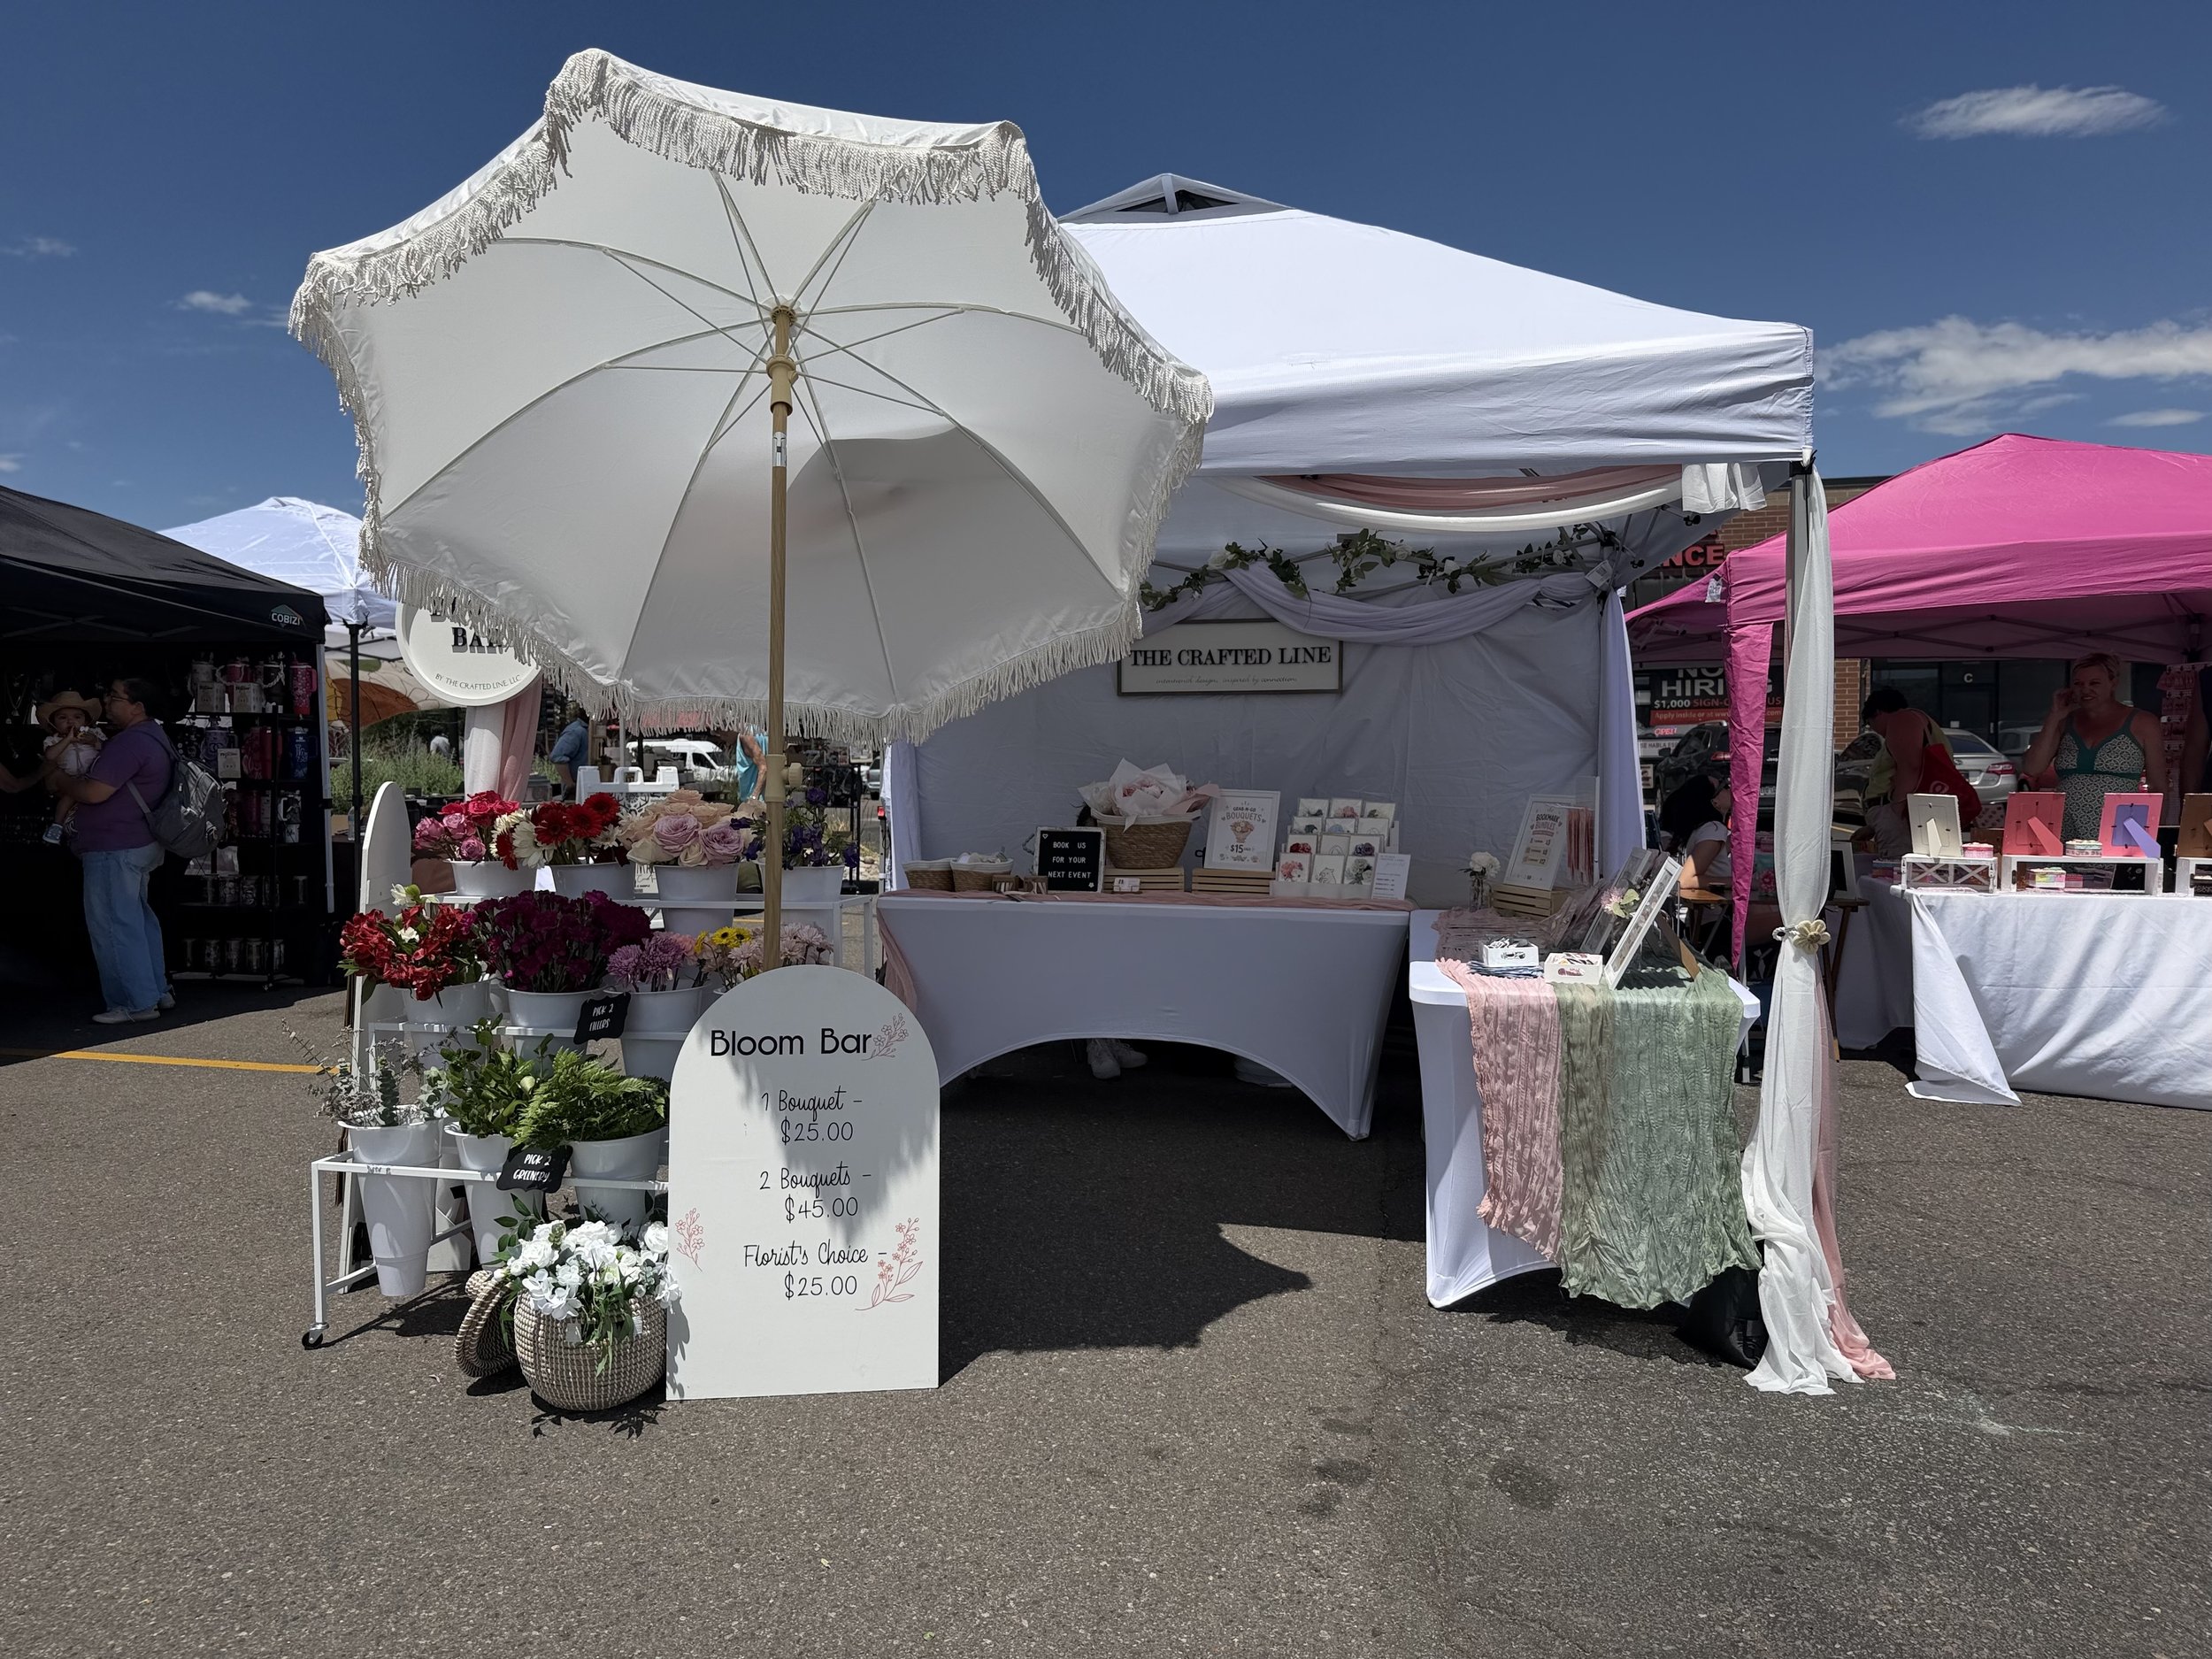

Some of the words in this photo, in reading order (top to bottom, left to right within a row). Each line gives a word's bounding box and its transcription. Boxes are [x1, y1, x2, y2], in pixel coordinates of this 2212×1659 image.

[272, 612, 300, 626] COBIZI
[1131, 649, 1171, 666] THE
[1177, 648, 1271, 665] CRAFTED
[1278, 646, 1332, 664] LINE
[445, 677, 458, 687] THE
[459, 681, 492, 690] CRAFTED
[510, 674, 521, 685] LLC
[1963, 672, 1973, 683] C
[1654, 699, 1691, 709] $1,000
[1655, 711, 1675, 720] Apply
[1225, 811, 1263, 822] BOUQUETS
[1230, 843, 1244, 854] $15
[592, 1005, 607, 1017] PICK
[608, 1002, 614, 1013] 2
[710, 1029, 804, 1056] Bloom
[820, 1027, 872, 1055] Bar
[761, 1092, 770, 1111] 1
[778, 1085, 847, 1122] Bouquet
[780, 1116, 854, 1146] $25.00
[523, 1154, 543, 1165] PICK
[544, 1156, 552, 1166] 2
[512, 1169, 550, 1183] GREENERY
[759, 1171, 771, 1190] 2
[780, 1161, 851, 1198] Bouquets
[785, 1194, 858, 1224] $45.00
[743, 1240, 809, 1268] Florist's
[818, 1238, 869, 1265] Choice
[784, 1271, 857, 1301] $25.00
